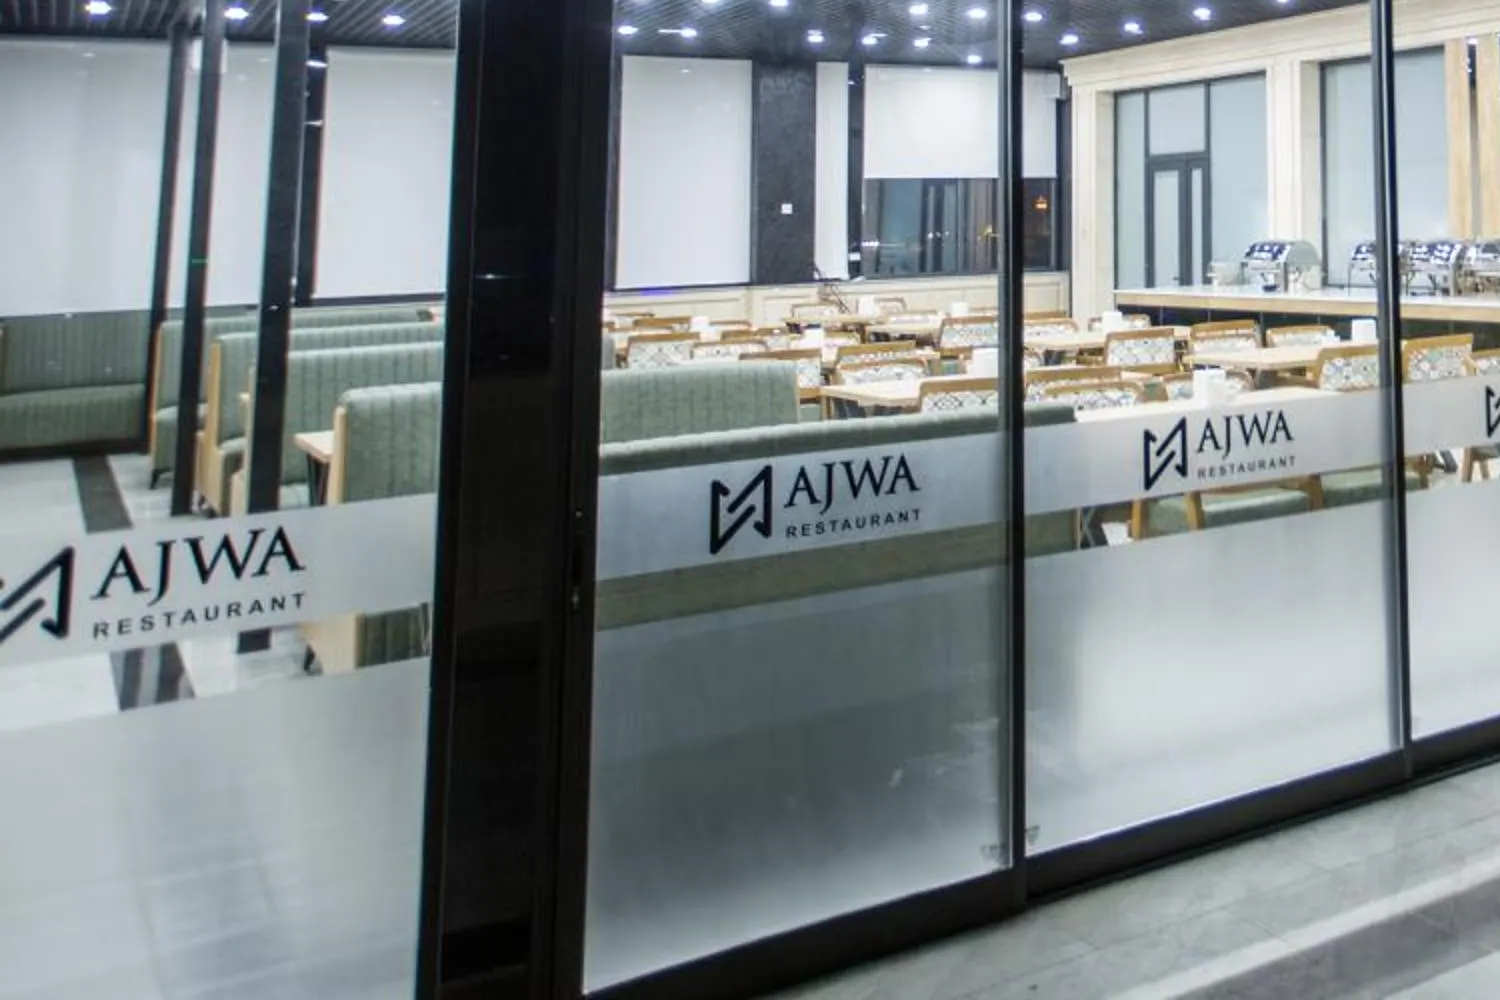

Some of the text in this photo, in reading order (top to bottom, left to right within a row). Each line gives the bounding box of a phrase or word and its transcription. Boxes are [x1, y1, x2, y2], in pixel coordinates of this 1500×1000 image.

[1196, 408, 1295, 460] AJWA
[783, 452, 922, 516] AJWA
[1197, 455, 1296, 479] RESTAURANT
[785, 508, 922, 539] RESTAURANT
[89, 525, 307, 607] AJWA
[92, 592, 306, 641] RESTAURANT
